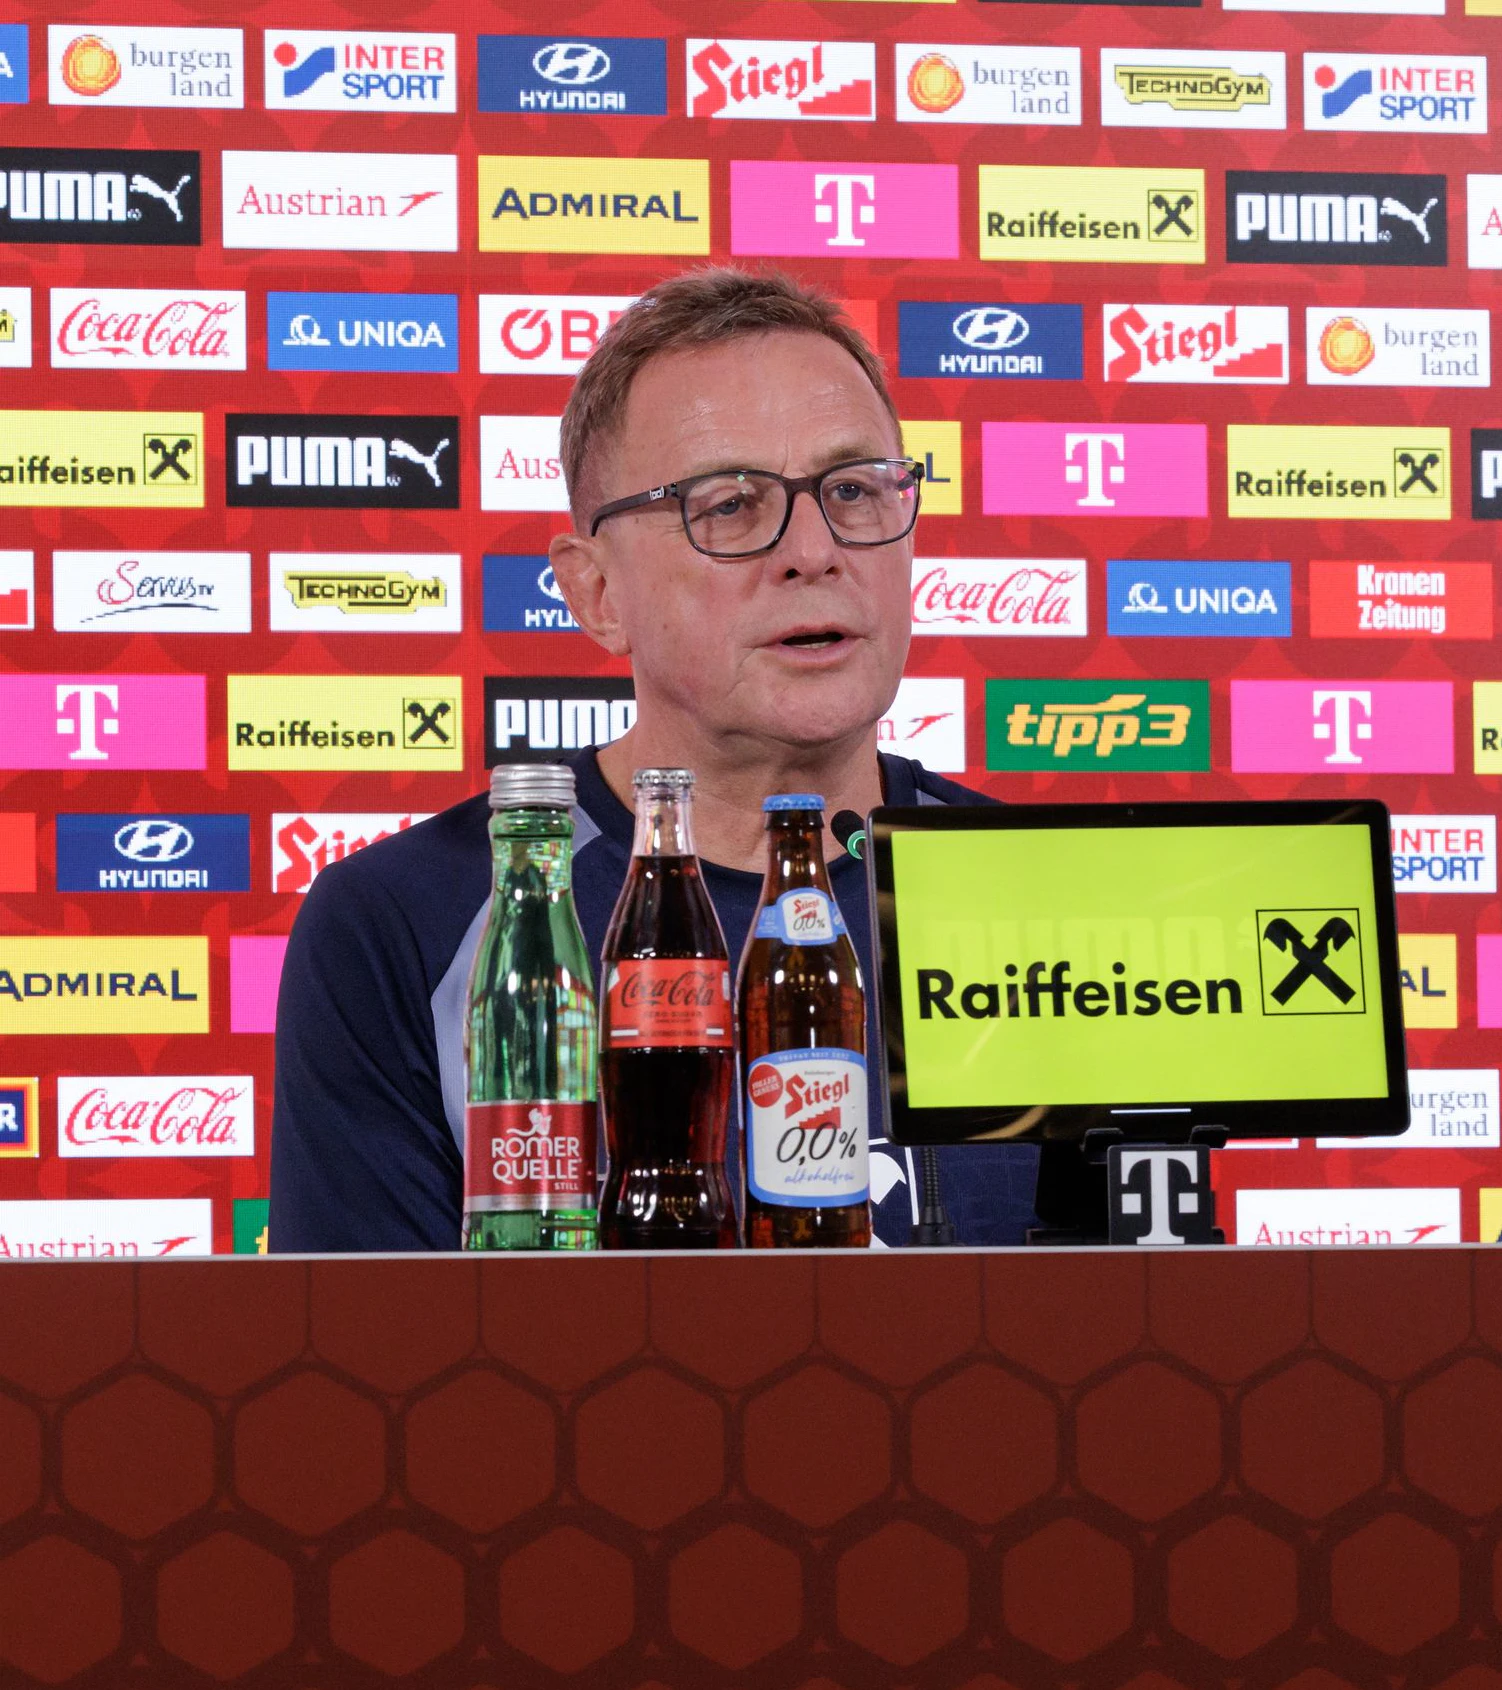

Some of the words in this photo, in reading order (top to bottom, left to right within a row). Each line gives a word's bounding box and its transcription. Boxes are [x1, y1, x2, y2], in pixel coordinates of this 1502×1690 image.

[130, 43, 232, 76] burgen
[345, 44, 444, 71] INTER
[171, 70, 232, 97] land
[343, 73, 444, 100] SPORT
[692, 42, 824, 117] Stiegl
[973, 61, 1070, 95] burgen
[1380, 67, 1474, 93] INTER
[520, 90, 625, 110] HYUNDAI
[1012, 91, 1070, 114] land
[1380, 95, 1476, 121] SPORT
[0, 171, 126, 221] UMA
[237, 185, 387, 216] Austrian
[492, 188, 698, 223] ADMIRAL
[815, 174, 875, 246] T
[988, 210, 1140, 239] Raiffeisen
[1236, 193, 1377, 242] PUMA
[57, 299, 234, 357] Coca-Cola
[339, 321, 445, 347] UNIQA
[501, 308, 622, 361] ÖB
[1108, 304, 1237, 383] Stiegl
[1385, 323, 1477, 358] burgen
[940, 355, 1042, 373] HYUNDAI
[1422, 354, 1479, 376] land
[0, 456, 135, 485] aiffeisen
[237, 436, 386, 486] PUMA
[1065, 433, 1124, 506] T
[1236, 470, 1386, 497] Raiffeisen
[912, 568, 1078, 624] Coca-Cola
[1358, 565, 1445, 595] Kronen
[1175, 587, 1277, 614] UNIQA
[1358, 600, 1446, 635] Zeitung
[56, 685, 119, 760] T
[236, 721, 395, 749] Raiffeisen
[1007, 694, 1191, 757] tipp3
[1313, 690, 1372, 764] T
[100, 870, 208, 888] HYUNDAI
[1392, 857, 1484, 882] SPORT
[0, 970, 197, 1002] ADMIRAL
[622, 971, 716, 1007] Coca-Cola
[917, 961, 1242, 1019] Raiffeisen
[785, 1073, 849, 1119] Stiegl
[1410, 1091, 1488, 1124] urgen
[65, 1088, 246, 1145] Coca-Cola
[1431, 1113, 1489, 1136] land
[776, 1122, 858, 1166] 0,0%
[492, 1159, 579, 1185] QUELLE
[554, 1182, 579, 1191] STILL
[1255, 1222, 1392, 1244] Austrian
